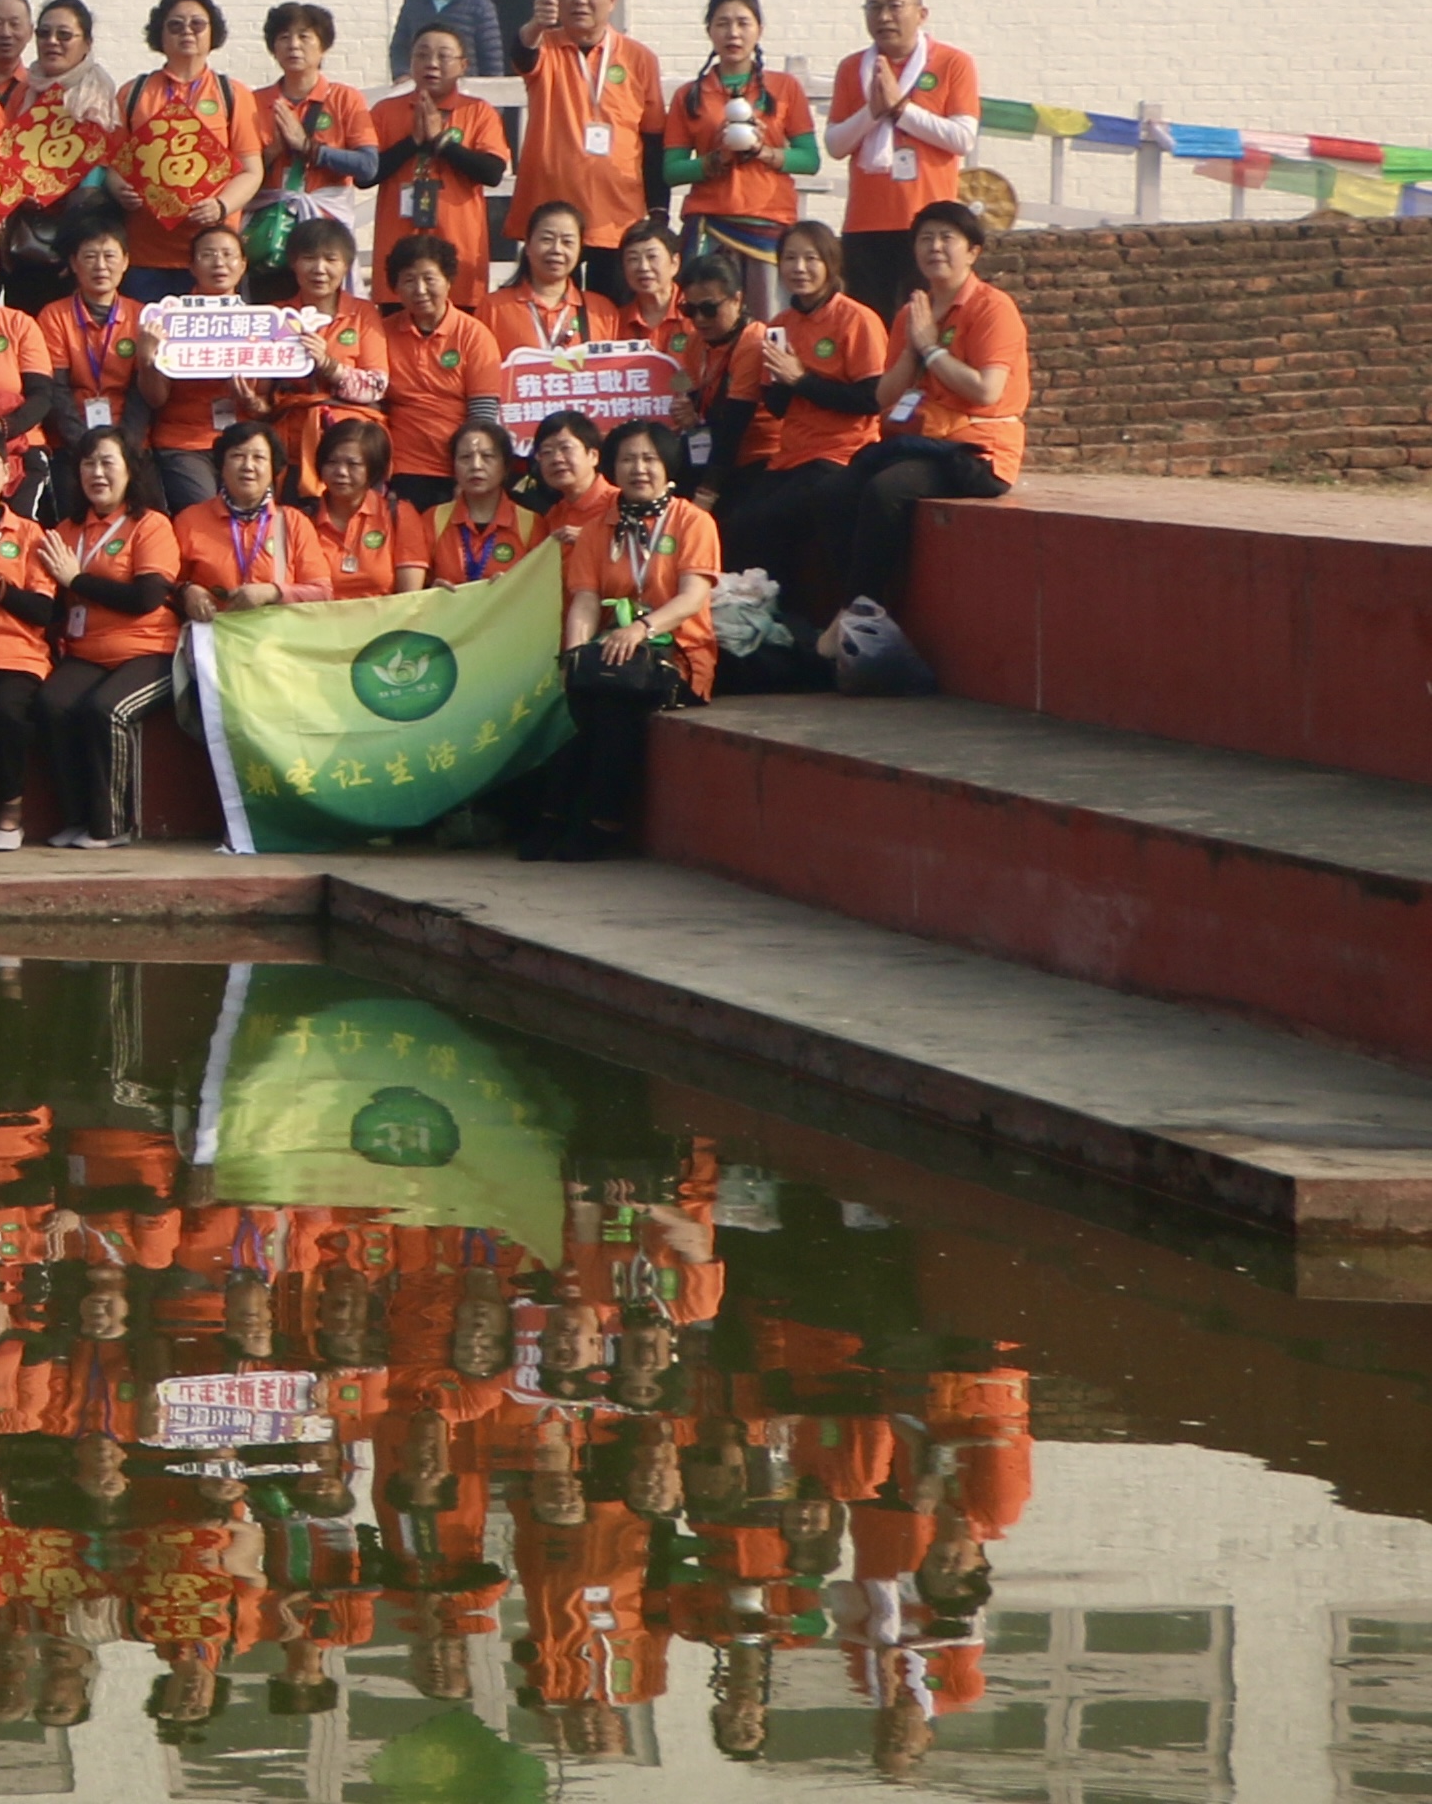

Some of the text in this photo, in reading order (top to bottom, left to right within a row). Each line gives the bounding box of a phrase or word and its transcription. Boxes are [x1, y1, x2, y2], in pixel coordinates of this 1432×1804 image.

[16, 105, 86, 169] 福
[135, 118, 209, 188] 福
[169, 314, 272, 338] 尼泊尔朝圣
[178, 347, 296, 367] 让生活更美好
[516, 368, 651, 398] 我在蓝毗尼
